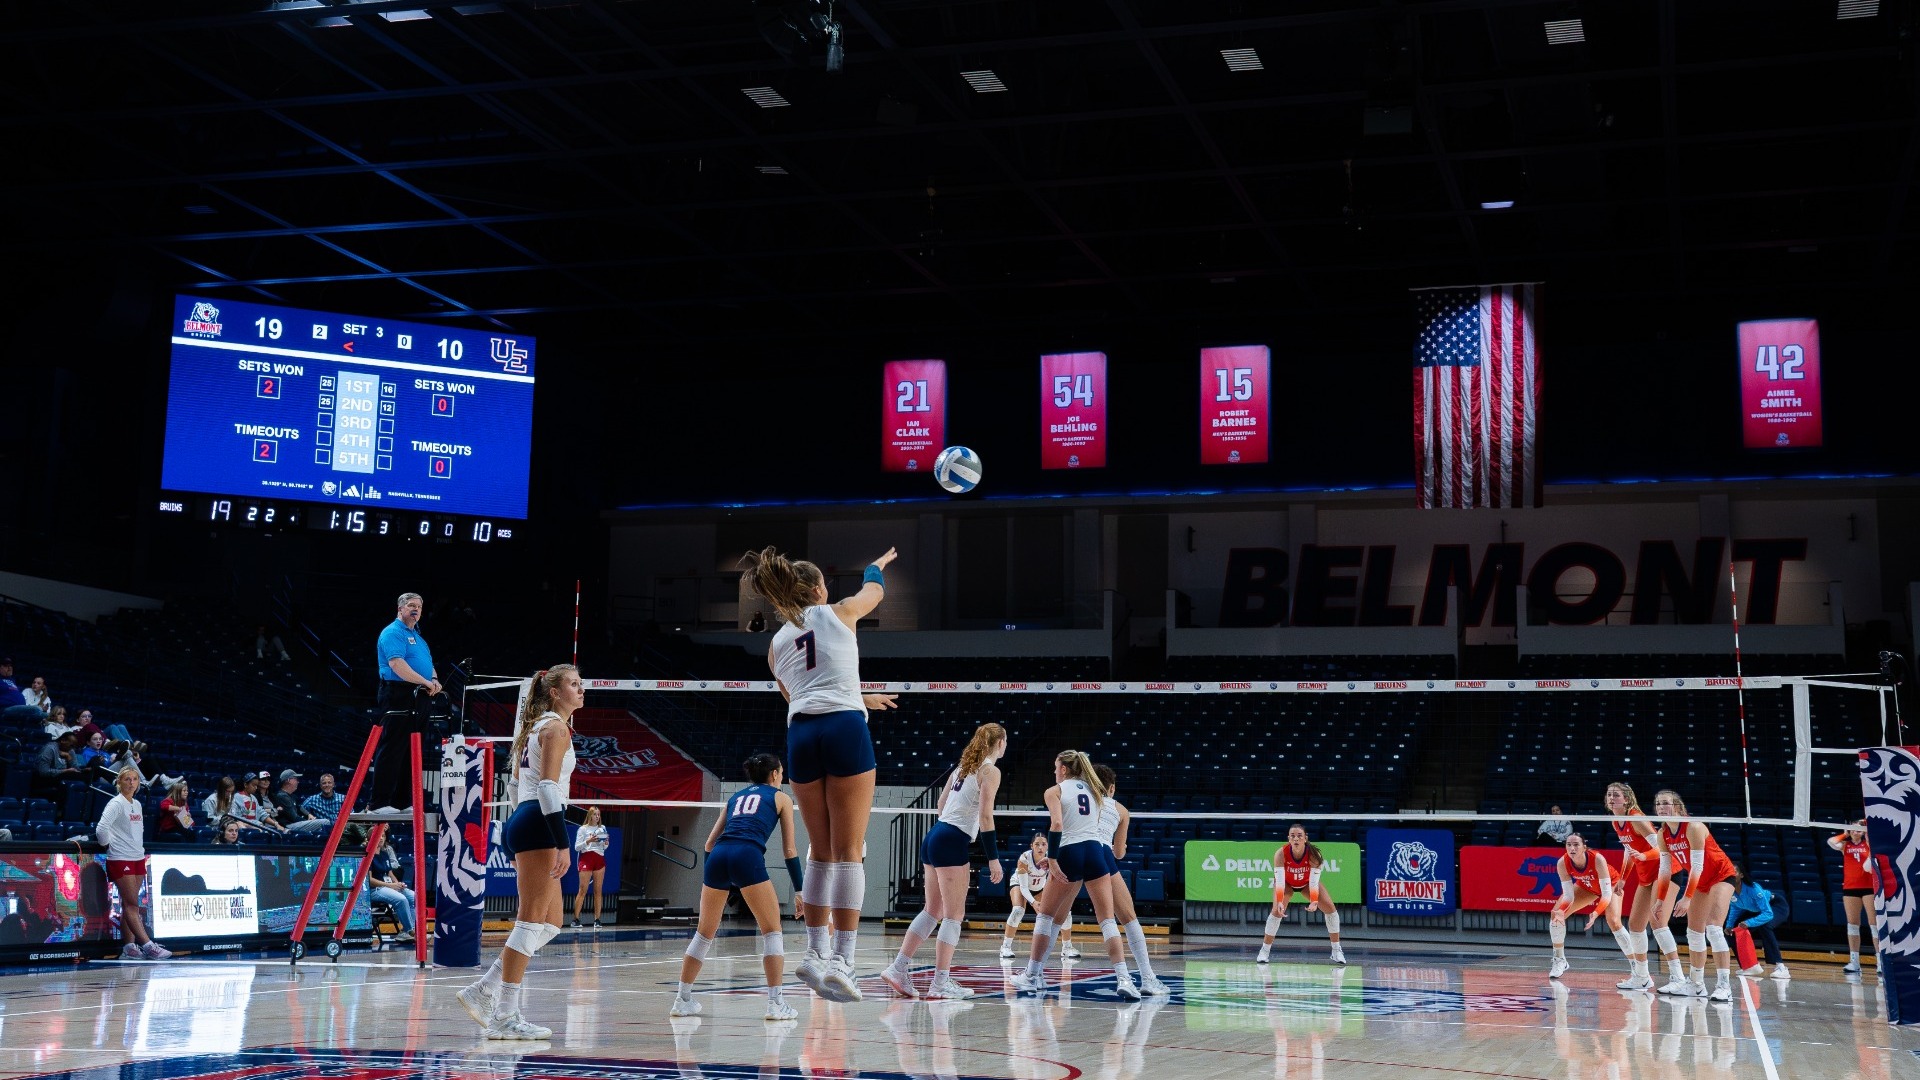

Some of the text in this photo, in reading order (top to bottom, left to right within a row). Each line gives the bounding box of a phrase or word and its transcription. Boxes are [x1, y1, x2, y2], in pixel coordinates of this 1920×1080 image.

[186, 321, 221, 334] BELMONT
[255, 316, 283, 340] 19
[343, 323, 384, 338] SET 3
[437, 338, 463, 361] 10
[490, 337, 528, 374] UE
[238, 359, 304, 376] SETS WON
[1755, 343, 1805, 381] 42
[263, 379, 274, 394] 2
[321, 379, 332, 388] 25
[345, 379, 372, 394] 1ST
[383, 385, 393, 394] 16
[414, 378, 475, 395] SETS WON
[1215, 367, 1253, 402] 15
[896, 379, 931, 413] 21
[1053, 374, 1094, 409] 54
[1766, 389, 1795, 398] AIMEE
[320, 397, 331, 406] 25
[341, 398, 373, 412] 2ND
[382, 404, 392, 412] 12
[438, 398, 447, 412] 0
[1760, 397, 1802, 408] SMITH
[1066, 416, 1080, 424] JOE
[1219, 409, 1250, 417] ROBERT
[340, 415, 372, 430] 3RD
[1050, 422, 1098, 433] BEHLING
[1212, 417, 1257, 428] BARNES
[234, 423, 299, 440] TIMEOUTS
[895, 427, 930, 437] CLARK
[339, 433, 370, 448] 4TH
[260, 443, 270, 458] 2
[411, 440, 472, 456] TIMEOUTS
[338, 451, 368, 466] 5TH
[435, 460, 445, 473] 0
[159, 501, 183, 512] BRUINS
[211, 500, 232, 521] 19
[247, 506, 258, 521] 2
[265, 508, 275, 522] 2
[330, 510, 365, 532] 1:15
[379, 520, 388, 535] 3
[420, 521, 429, 535] 0
[444, 523, 453, 536] 0
[473, 521, 492, 542] 10
[1219, 537, 1808, 627] BELMONT
[794, 628, 817, 672] 7
[723, 680, 750, 688] BELMONT
[1296, 682, 1327, 690] BELMONT
[1535, 680, 1571, 688] BRUINS
[1620, 679, 1654, 687] BELMONT
[1704, 678, 1741, 686] BRUINS
[732, 794, 761, 817] 10
[1077, 793, 1091, 816] 9
[1674, 851, 1687, 864] 17
[1225, 859, 1273, 872] DELTA
[1237, 877, 1263, 889] KID
[1293, 872, 1305, 881] 15
[1378, 881, 1444, 900] BELMONT
